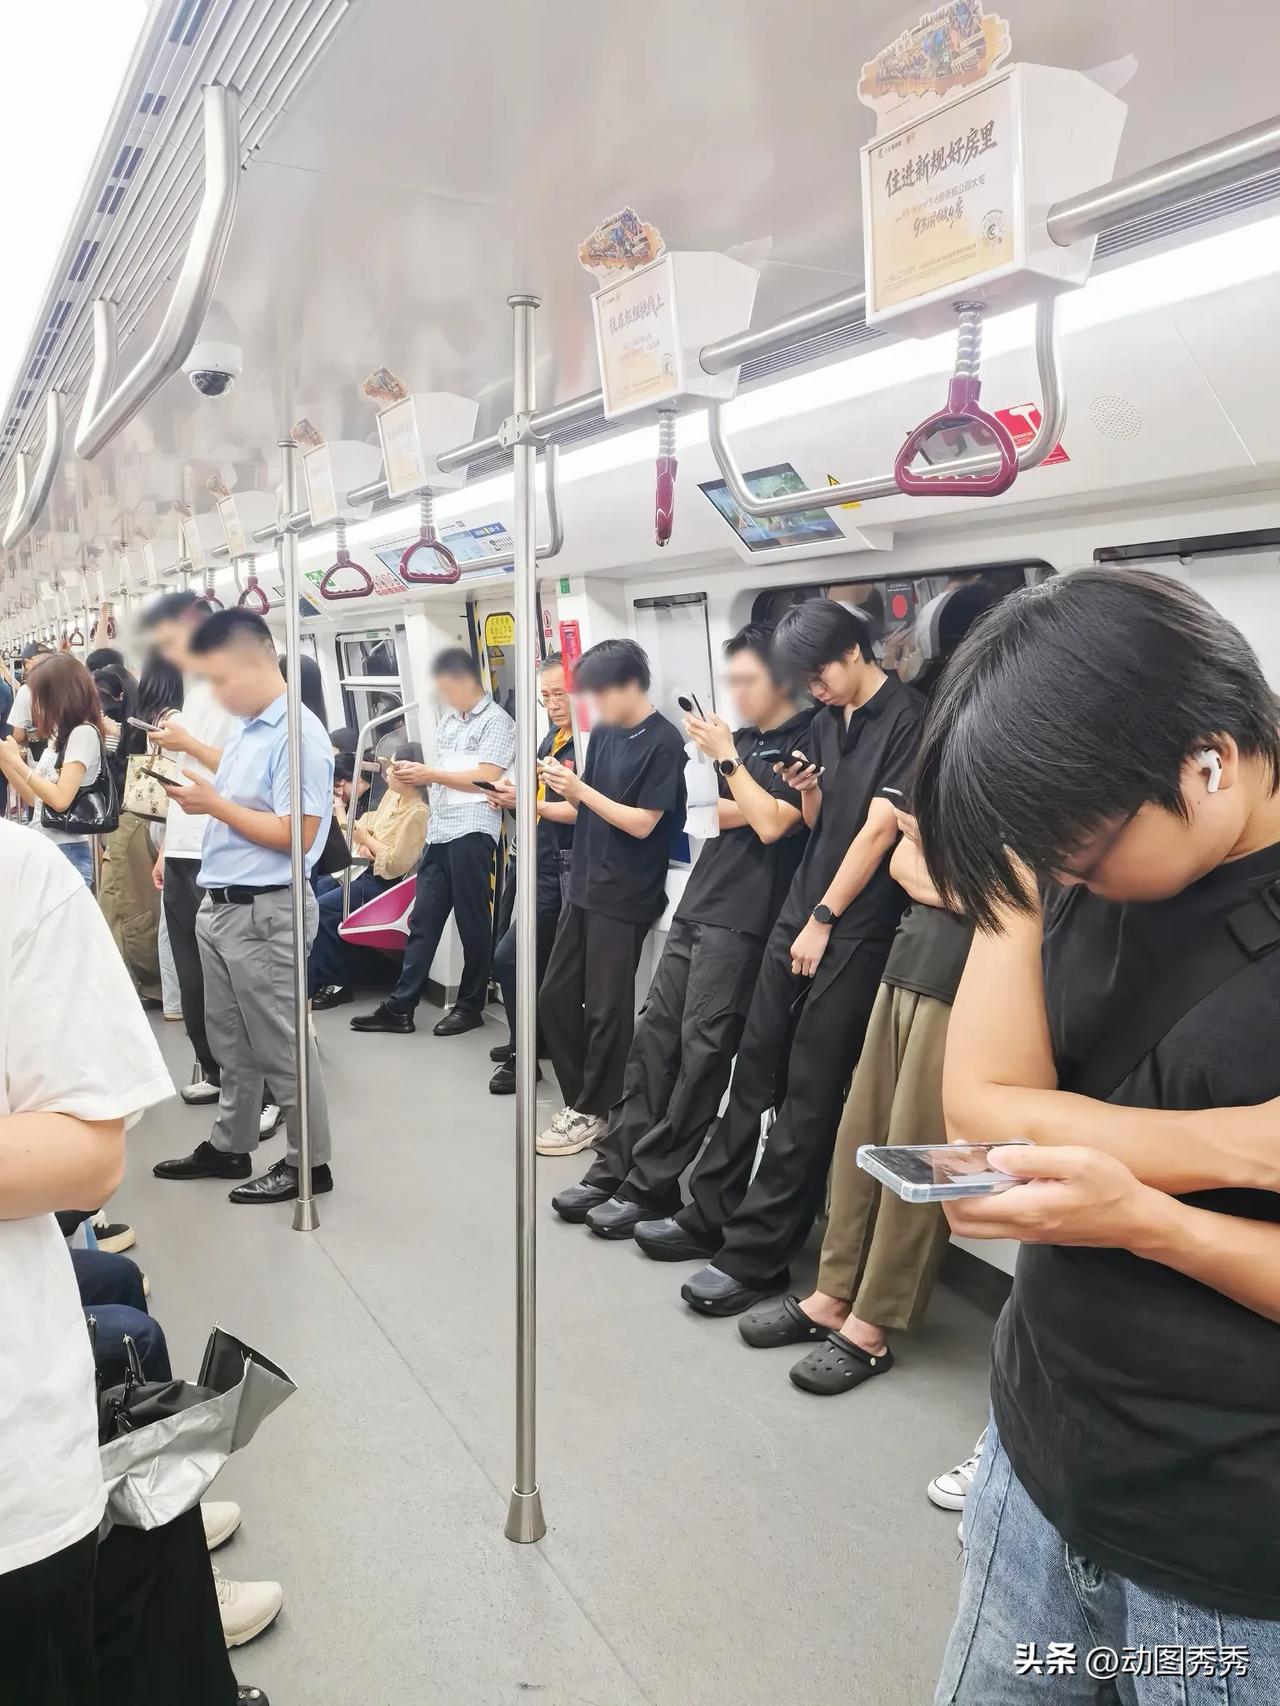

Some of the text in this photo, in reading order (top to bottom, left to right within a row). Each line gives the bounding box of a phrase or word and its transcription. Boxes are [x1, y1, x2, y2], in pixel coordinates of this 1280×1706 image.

[885, 119, 998, 198] 住进新规好房里
